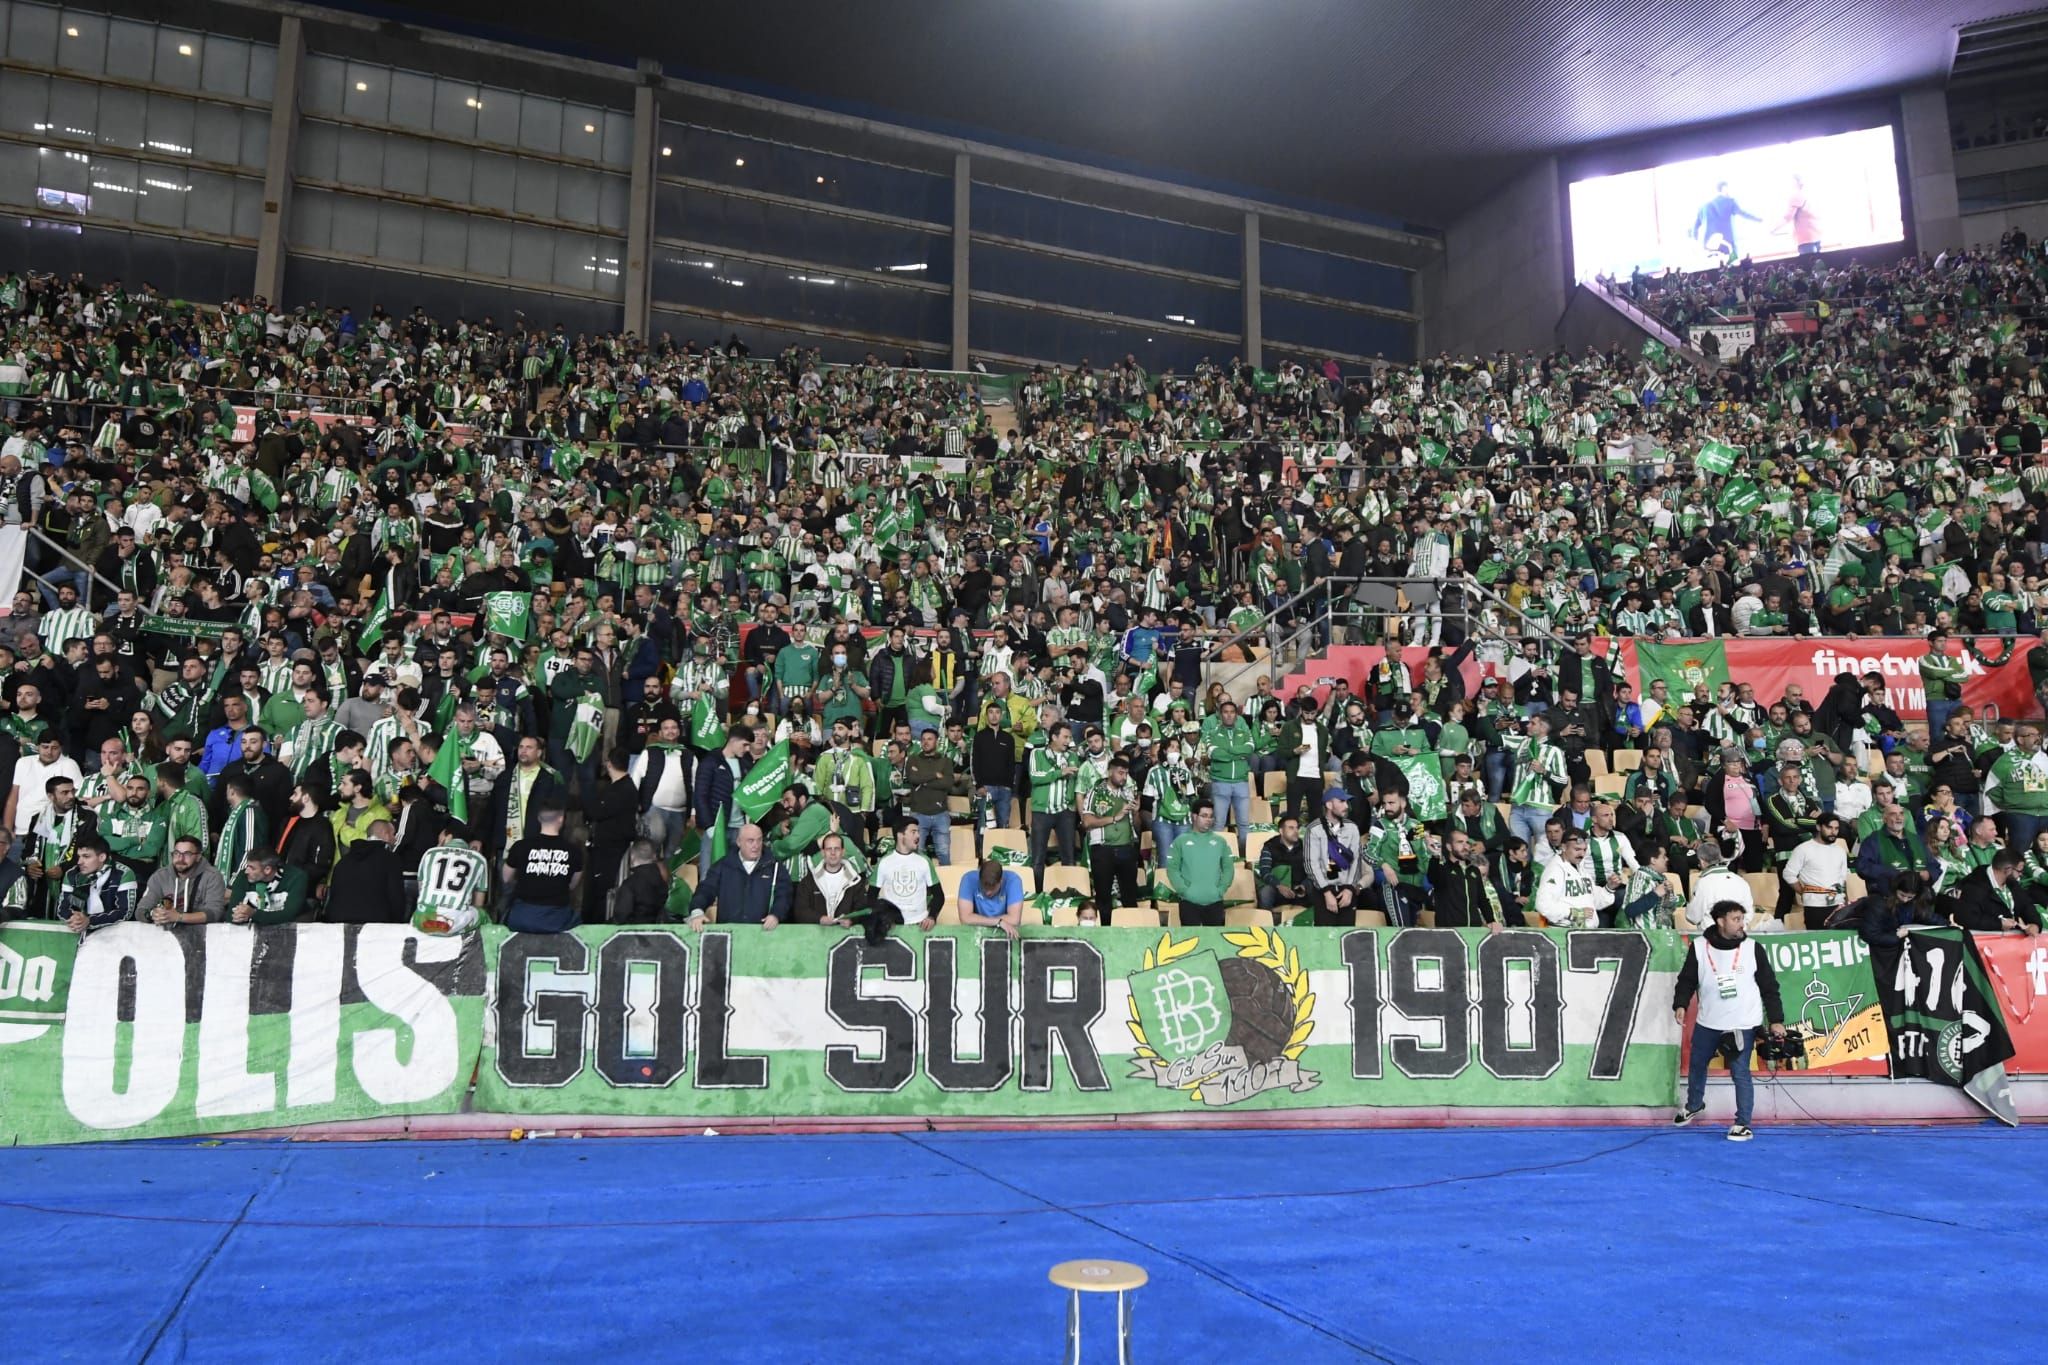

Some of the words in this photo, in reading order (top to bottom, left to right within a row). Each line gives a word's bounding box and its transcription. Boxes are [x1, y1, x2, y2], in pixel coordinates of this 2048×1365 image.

[436, 858, 471, 891] 13
[495, 930, 769, 1089] GOL
[825, 934, 1112, 1092] SUR
[1340, 928, 1653, 1081] 1907
[1200, 1040, 1238, 1076] Sur
[1843, 1028, 1872, 1053] 2017
[1221, 1056, 1286, 1097] 1907
